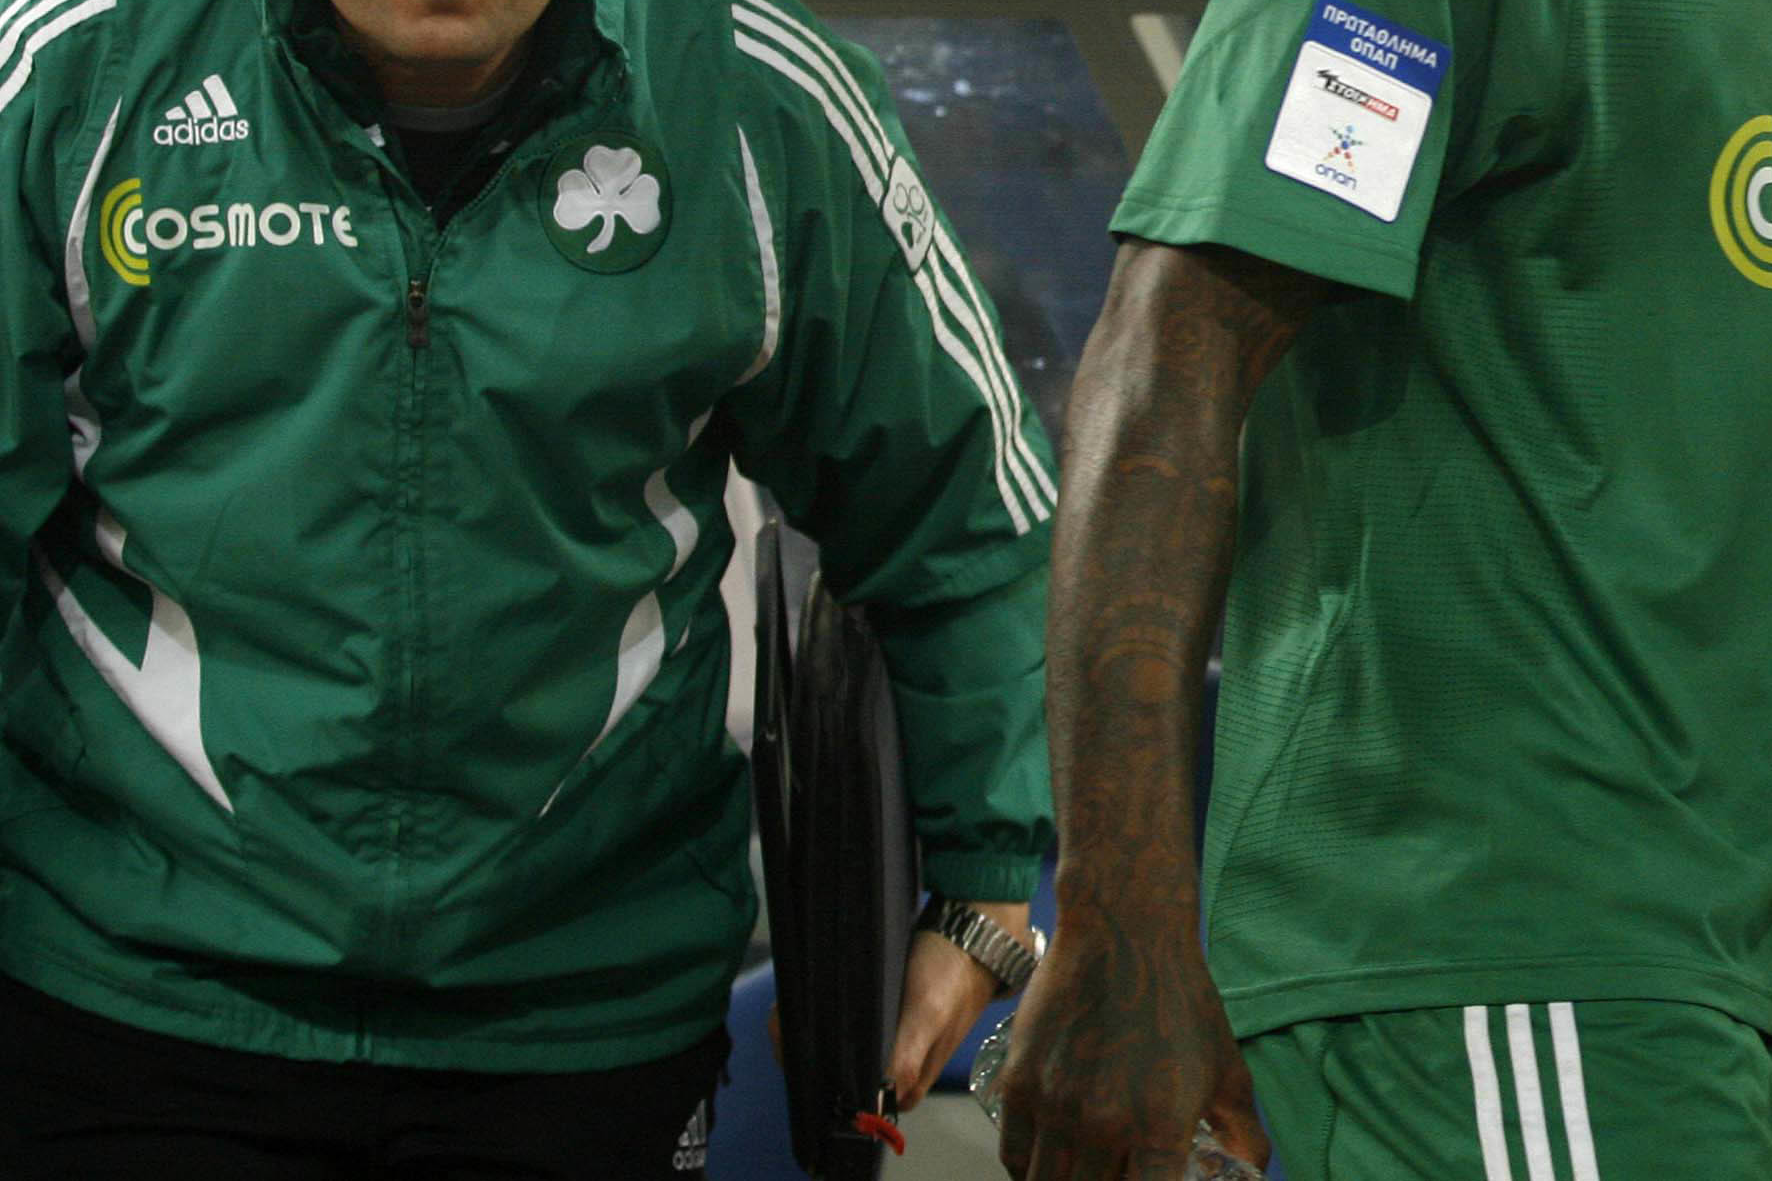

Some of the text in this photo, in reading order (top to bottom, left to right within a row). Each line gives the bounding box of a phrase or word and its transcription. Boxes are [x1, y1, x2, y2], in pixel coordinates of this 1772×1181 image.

[1322, 3, 1439, 69] ΠΡΩΤΑΘΛΗΜΑ
[1350, 36, 1399, 71] ΟΠΑΠ
[153, 117, 250, 147] adidas
[123, 201, 359, 256] COSMOTE
